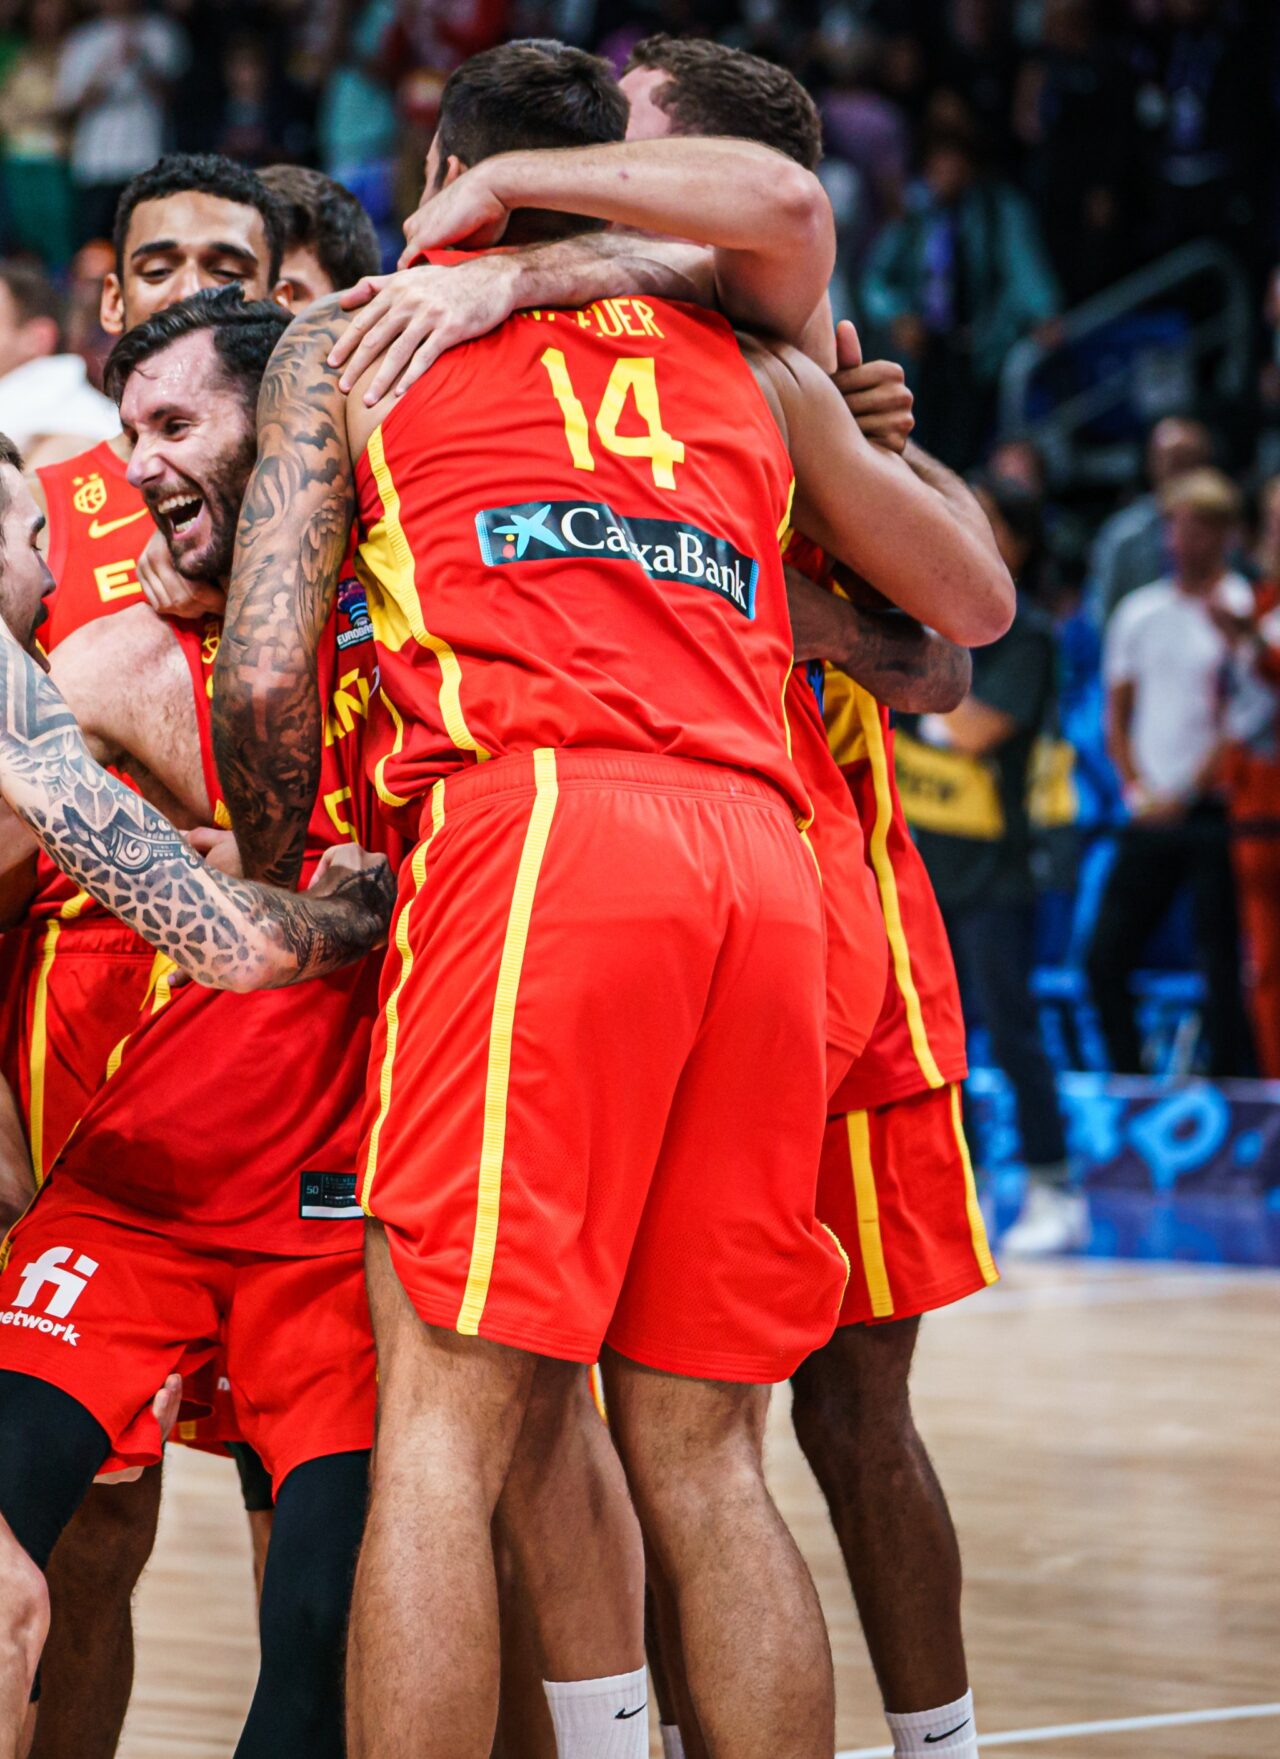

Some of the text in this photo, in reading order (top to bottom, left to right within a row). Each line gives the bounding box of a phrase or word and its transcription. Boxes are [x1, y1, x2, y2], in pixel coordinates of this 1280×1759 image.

[540, 347, 685, 490] 14
[561, 507, 747, 610] CaxaBank
[11, 1246, 99, 1319] fi
